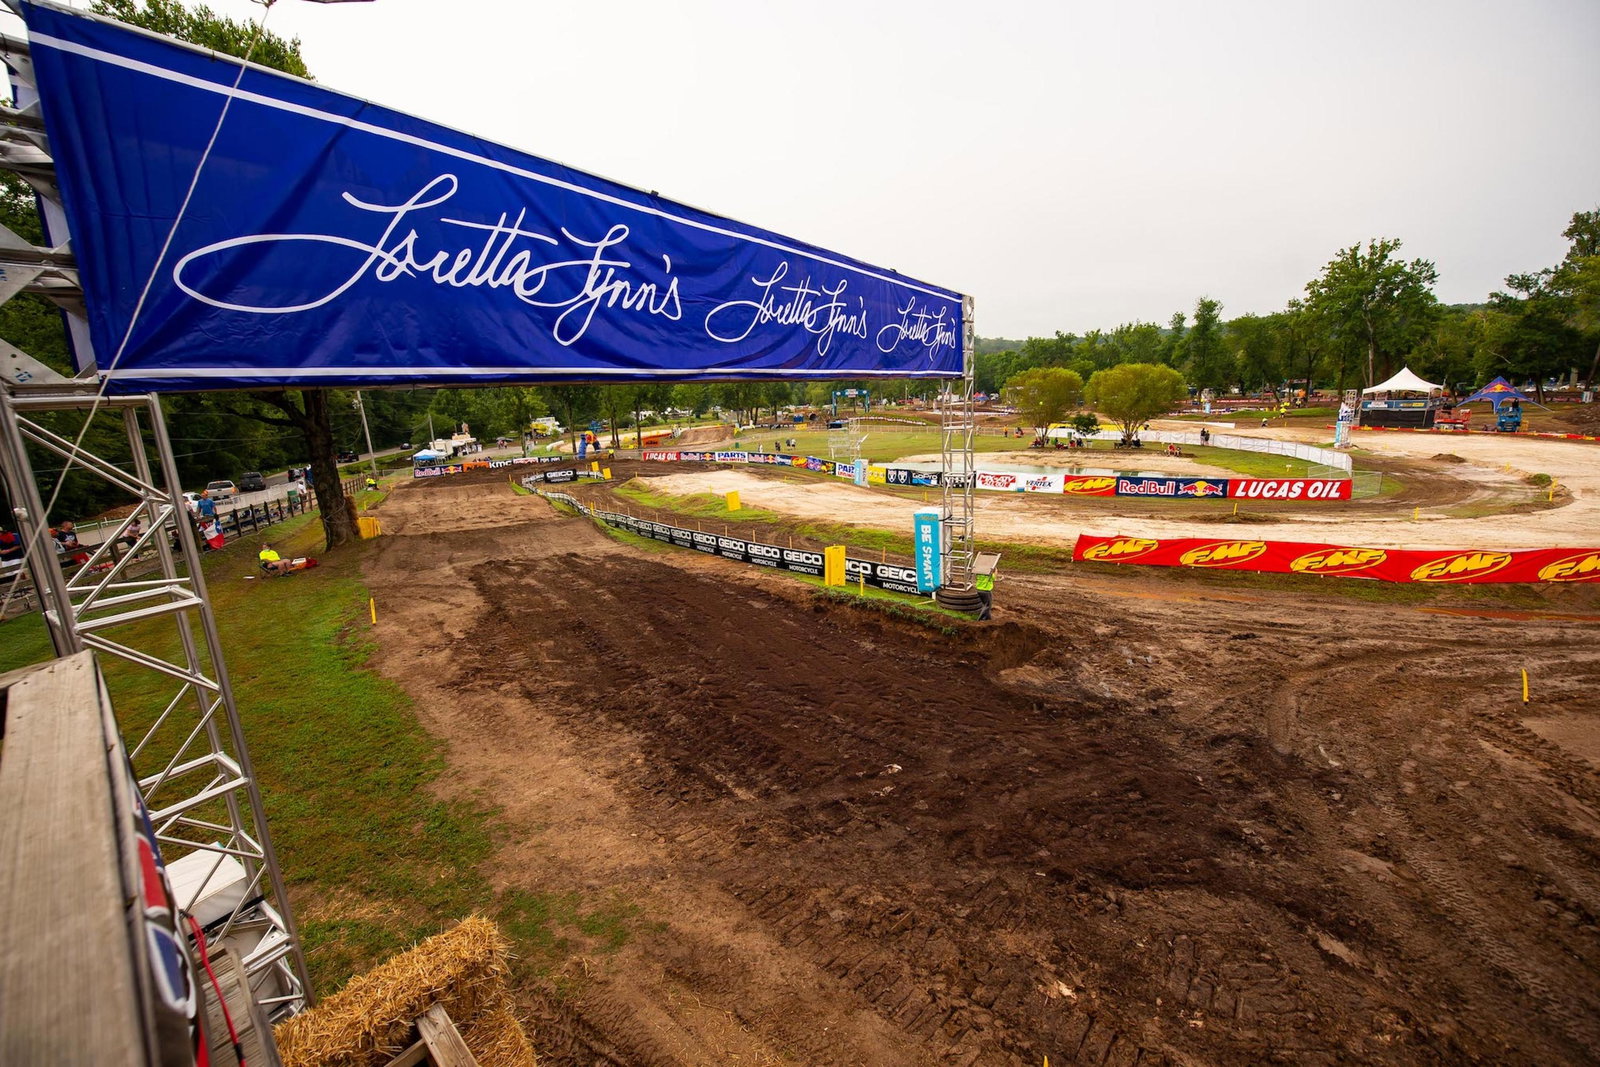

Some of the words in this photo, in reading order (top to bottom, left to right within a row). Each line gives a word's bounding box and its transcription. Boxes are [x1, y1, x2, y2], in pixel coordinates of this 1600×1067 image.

[173, 173, 559, 313] Loretta
[516, 224, 682, 346] Lynn's
[705, 261, 822, 342] Loretta
[804, 279, 867, 357] Lynn's
[876, 296, 932, 353] Loretta
[546, 470, 573, 478] GEICO
[912, 472, 938, 480] GoPro
[1064, 477, 1117, 491] FMF
[1234, 481, 1304, 498] LUCAS
[1307, 481, 1342, 498] OIL
[671, 528, 692, 540] GEICO
[693, 533, 716, 545] GEICO
[921, 524, 932, 544] BE
[718, 538, 745, 551] GEICO
[747, 544, 780, 558] GEICO
[722, 551, 742, 560] MOTORCYCLE
[751, 558, 777, 567] MOTORCYCLE
[783, 550, 822, 565] GEICO
[1084, 538, 1157, 560] FMF
[1180, 541, 1266, 565] FMF
[1291, 549, 1386, 572] FMF
[1410, 552, 1511, 581] FMF
[1538, 555, 1600, 582] FM
[788, 565, 819, 575] MOTORCYCLE
[845, 560, 872, 575] ICO
[876, 565, 917, 583] GEIC
[922, 546, 934, 588] SMART
